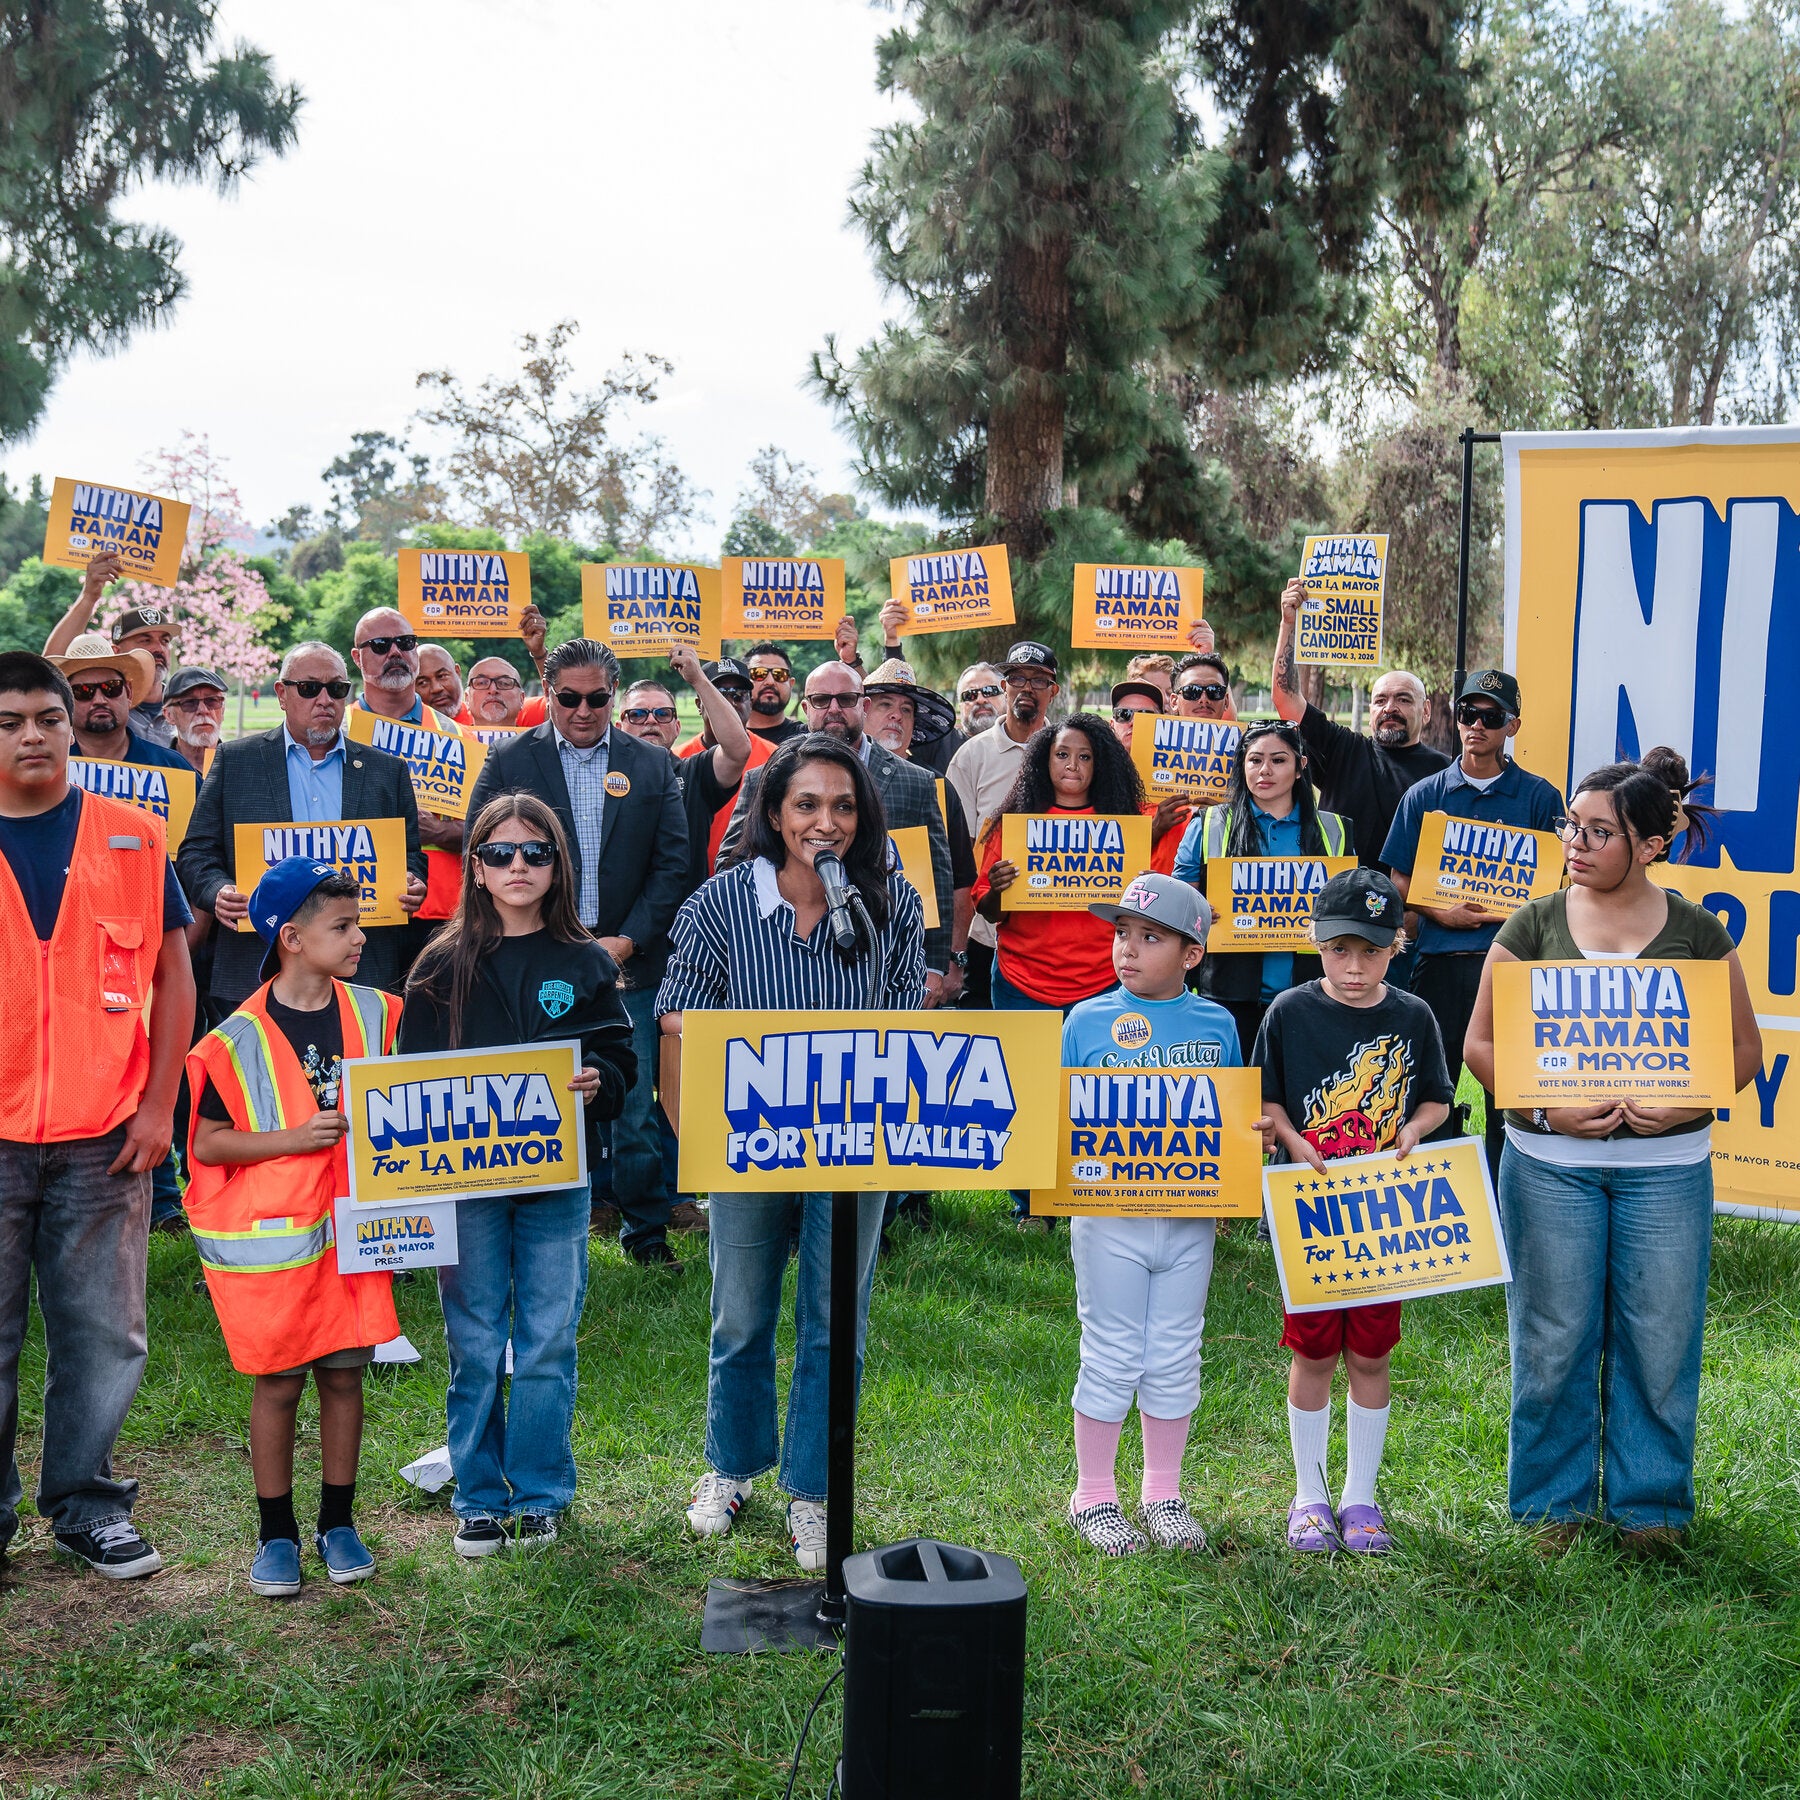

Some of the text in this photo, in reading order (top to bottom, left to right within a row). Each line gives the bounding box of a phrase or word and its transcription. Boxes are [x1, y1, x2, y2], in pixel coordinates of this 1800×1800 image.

[72, 484, 162, 532] NITHYA
[70, 516, 160, 549] RAMAN
[72, 537, 156, 562] FOR MAYOR
[1312, 538, 1377, 558] NITHYA
[420, 554, 509, 586] NITHYA
[742, 561, 824, 592] NITHYA
[908, 552, 988, 587] NITHYA
[1304, 554, 1382, 580] RAMAN
[422, 586, 508, 602] RAMAN
[606, 567, 701, 603] NITHYA
[911, 581, 989, 603] RAMAN
[1095, 568, 1181, 601] NITHYA
[1302, 579, 1379, 591] FOR LA MAYOR
[446, 604, 508, 616] MAYOR
[608, 602, 700, 620] RAMAN
[743, 592, 823, 607] RAMAN
[934, 598, 990, 613] MAYOR
[1095, 600, 1179, 616] RAMAN
[1326, 598, 1378, 616] SMALL
[765, 609, 823, 620] MAYOR
[1117, 618, 1178, 630] MAYOR
[1302, 615, 1378, 633] BUSINESS
[635, 622, 700, 635] MAYOR
[1300, 633, 1376, 650] CANDIDATE
[372, 719, 466, 770] NITHYA
[1154, 718, 1242, 757] NITHYA
[68, 760, 170, 804] NITHYA
[408, 760, 464, 785] MAN
[1175, 772, 1228, 788] MAYO
[411, 778, 461, 798] AYOR
[263, 825, 377, 866] NITHYA
[1027, 819, 1125, 854] NITHYA
[1442, 821, 1537, 868] NITHYA
[1028, 855, 1123, 872] RAMAN
[1440, 855, 1534, 886] RAMAN
[1053, 875, 1122, 887] MAYOR
[1232, 860, 1328, 895] NITHYA
[1441, 877, 1530, 900] FOR MAYOR
[1125, 882, 1159, 910] EV
[1232, 896, 1316, 913] RAMA
[1258, 916, 1310, 928] MAYO
[1530, 966, 1690, 1019] NITHYA
[1115, 1019, 1148, 1034] NITHYA
[1118, 1030, 1149, 1042] RAMAN
[1534, 1021, 1689, 1047] RAMAN
[1150, 1039, 1221, 1067] Valley
[1543, 1052, 1690, 1070] FOR MAYOR
[725, 1029, 1017, 1133] NITHYA
[366, 1073, 562, 1151] NITHYA
[1069, 1075, 1222, 1128] NITHYA
[727, 1121, 1011, 1173] FOR THE VALLEY
[1071, 1131, 1220, 1156] RAMAN
[373, 1139, 564, 1176] For LA MAYOR
[1711, 1151, 1729, 1160] FOR
[1734, 1154, 1769, 1166] MAYOR
[1079, 1162, 1220, 1180] FOR MAYOR
[1295, 1177, 1465, 1239] NITHYA
[357, 1216, 435, 1244] NITHYA
[360, 1242, 434, 1256] FOR LA MAYOR
[1304, 1222, 1471, 1264] For LA MAYOR
[375, 1257, 404, 1266] PRESS
